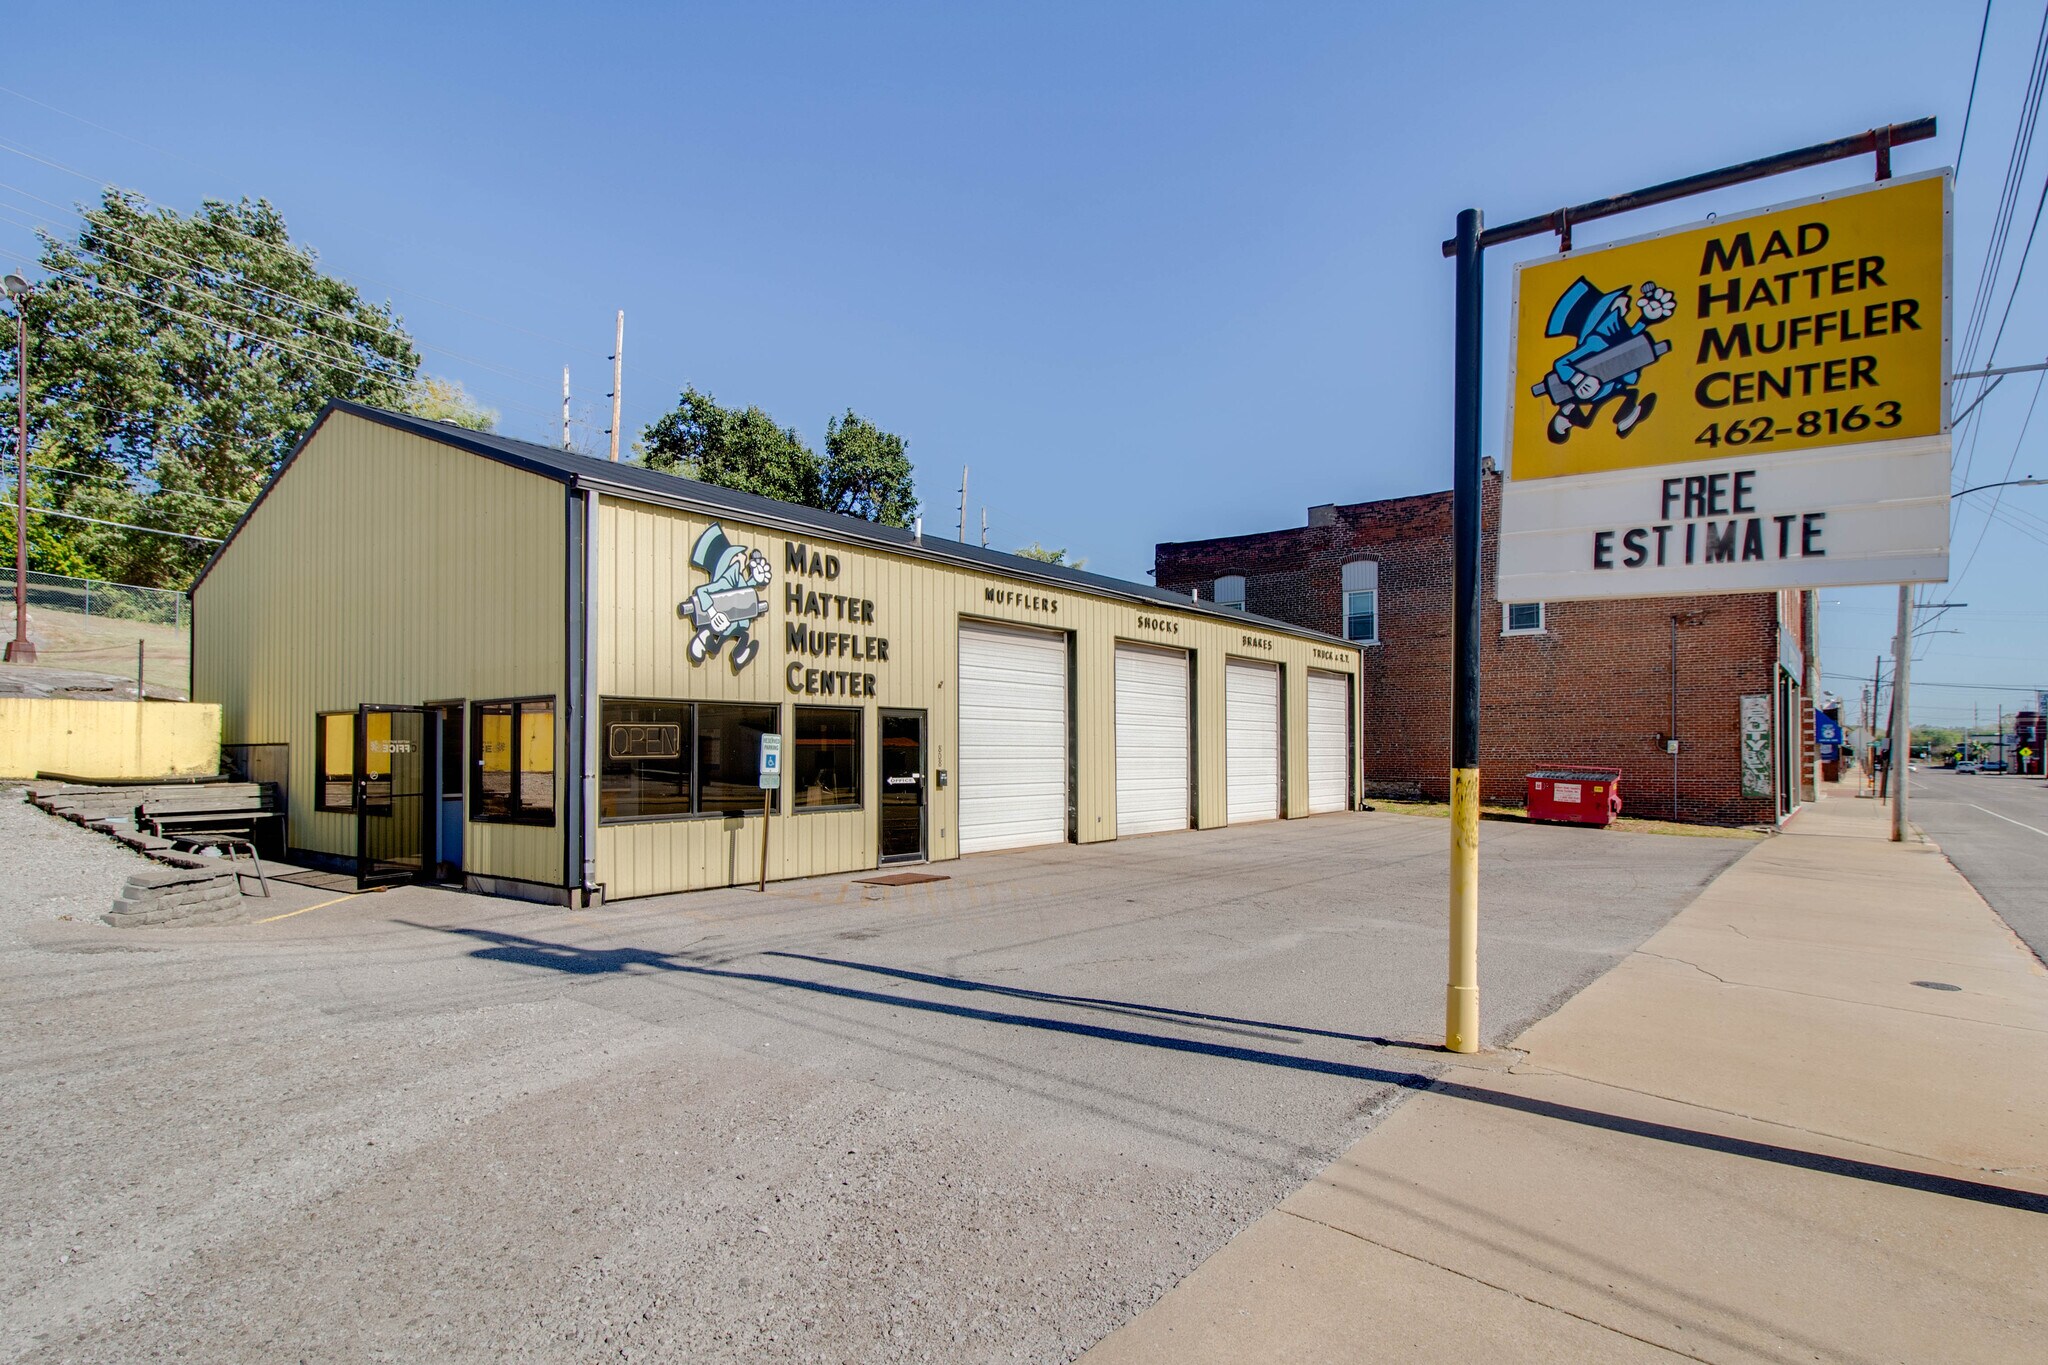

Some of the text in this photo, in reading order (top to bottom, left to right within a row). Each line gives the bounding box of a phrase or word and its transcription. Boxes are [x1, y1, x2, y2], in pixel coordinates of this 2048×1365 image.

[1699, 221, 1830, 277] MAD
[1697, 255, 1888, 319] HATTER
[1696, 298, 1923, 364] MUFFLER
[1694, 355, 1880, 409] CENTER
[1694, 400, 1903, 448] 462-8163
[1661, 470, 1757, 520] FREE
[785, 541, 841, 581] MAD
[1593, 512, 1826, 570] ESTIMATE
[785, 582, 875, 623] HATTER
[985, 587, 1058, 614] MUFFLERS
[785, 621, 890, 662] MUFFLER
[1137, 615, 1179, 634] SHOCKS
[1242, 635, 1273, 651] BRAKES
[1313, 648, 1333, 661] TRUCK
[786, 661, 877, 698] CENTER
[613, 727, 677, 754] OPEN
